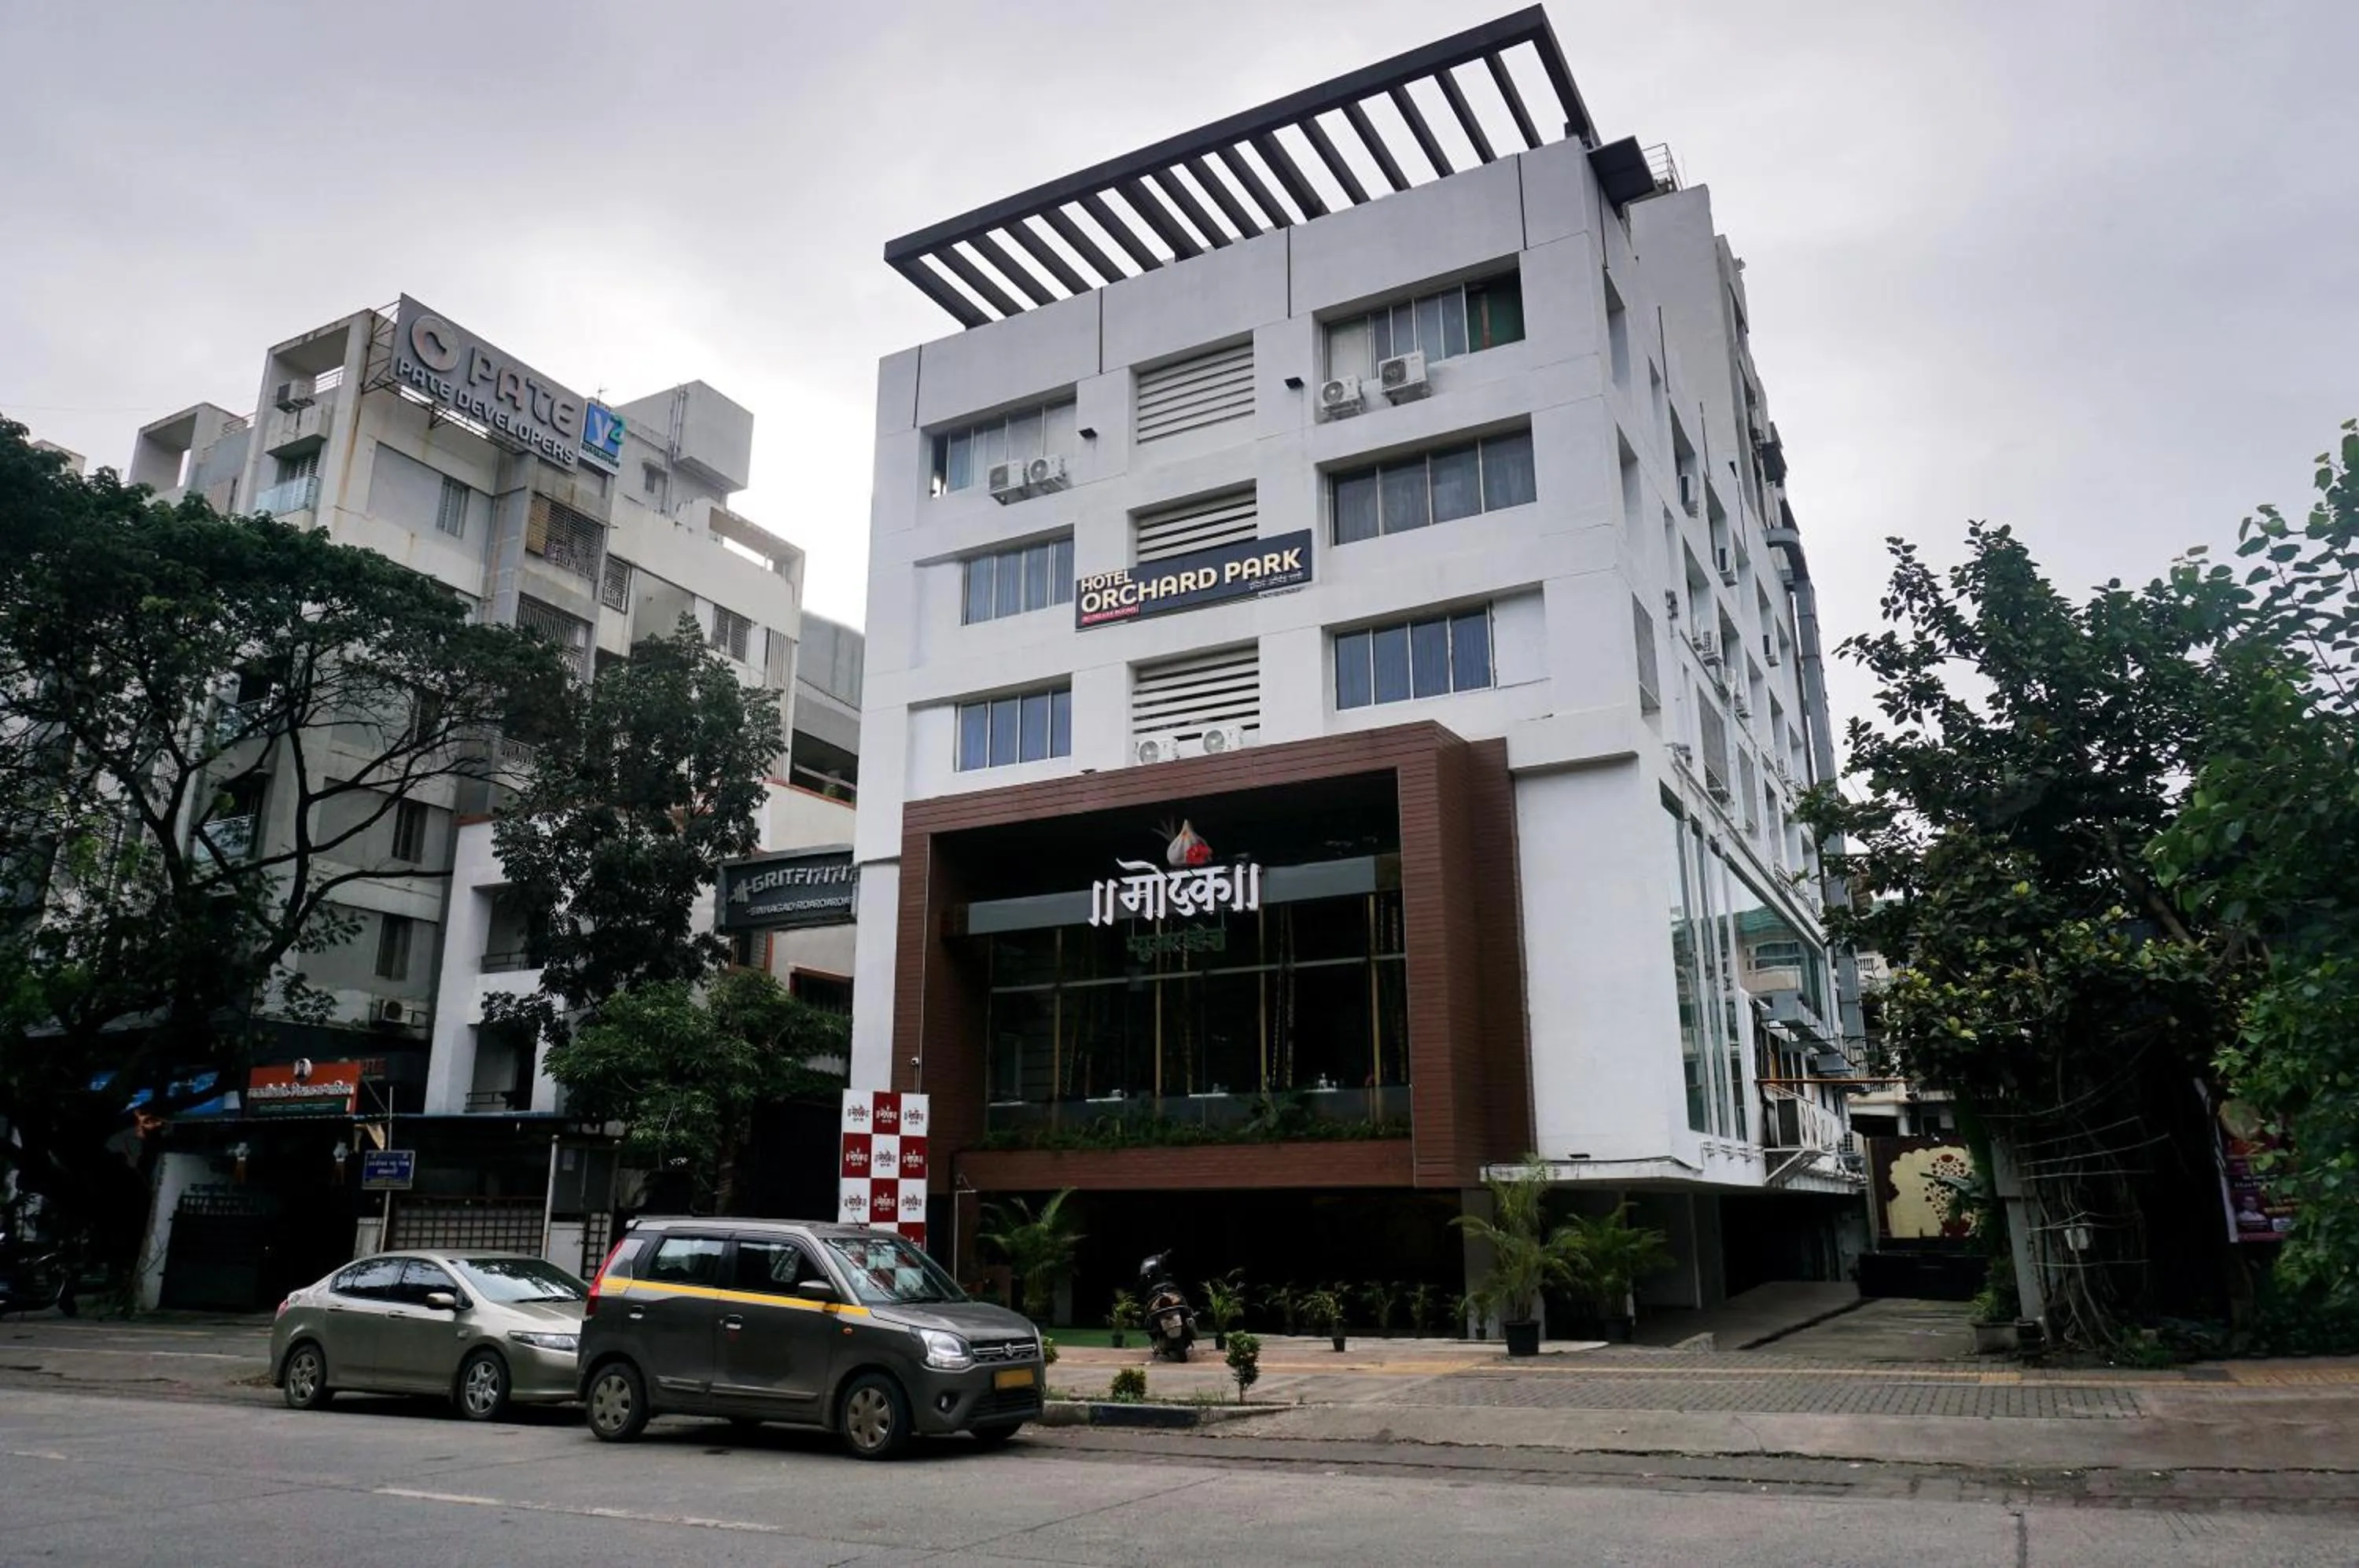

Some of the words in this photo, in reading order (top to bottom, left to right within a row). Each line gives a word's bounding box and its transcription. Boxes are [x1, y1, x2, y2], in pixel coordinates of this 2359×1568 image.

[397, 357, 451, 400] PATE
[455, 388, 576, 466] DEVELOPERS
[467, 345, 576, 438] PATE
[1081, 567, 1218, 613] ORCHARD
[1224, 547, 1301, 583] PARK
[1081, 570, 1133, 592] HOTEL
